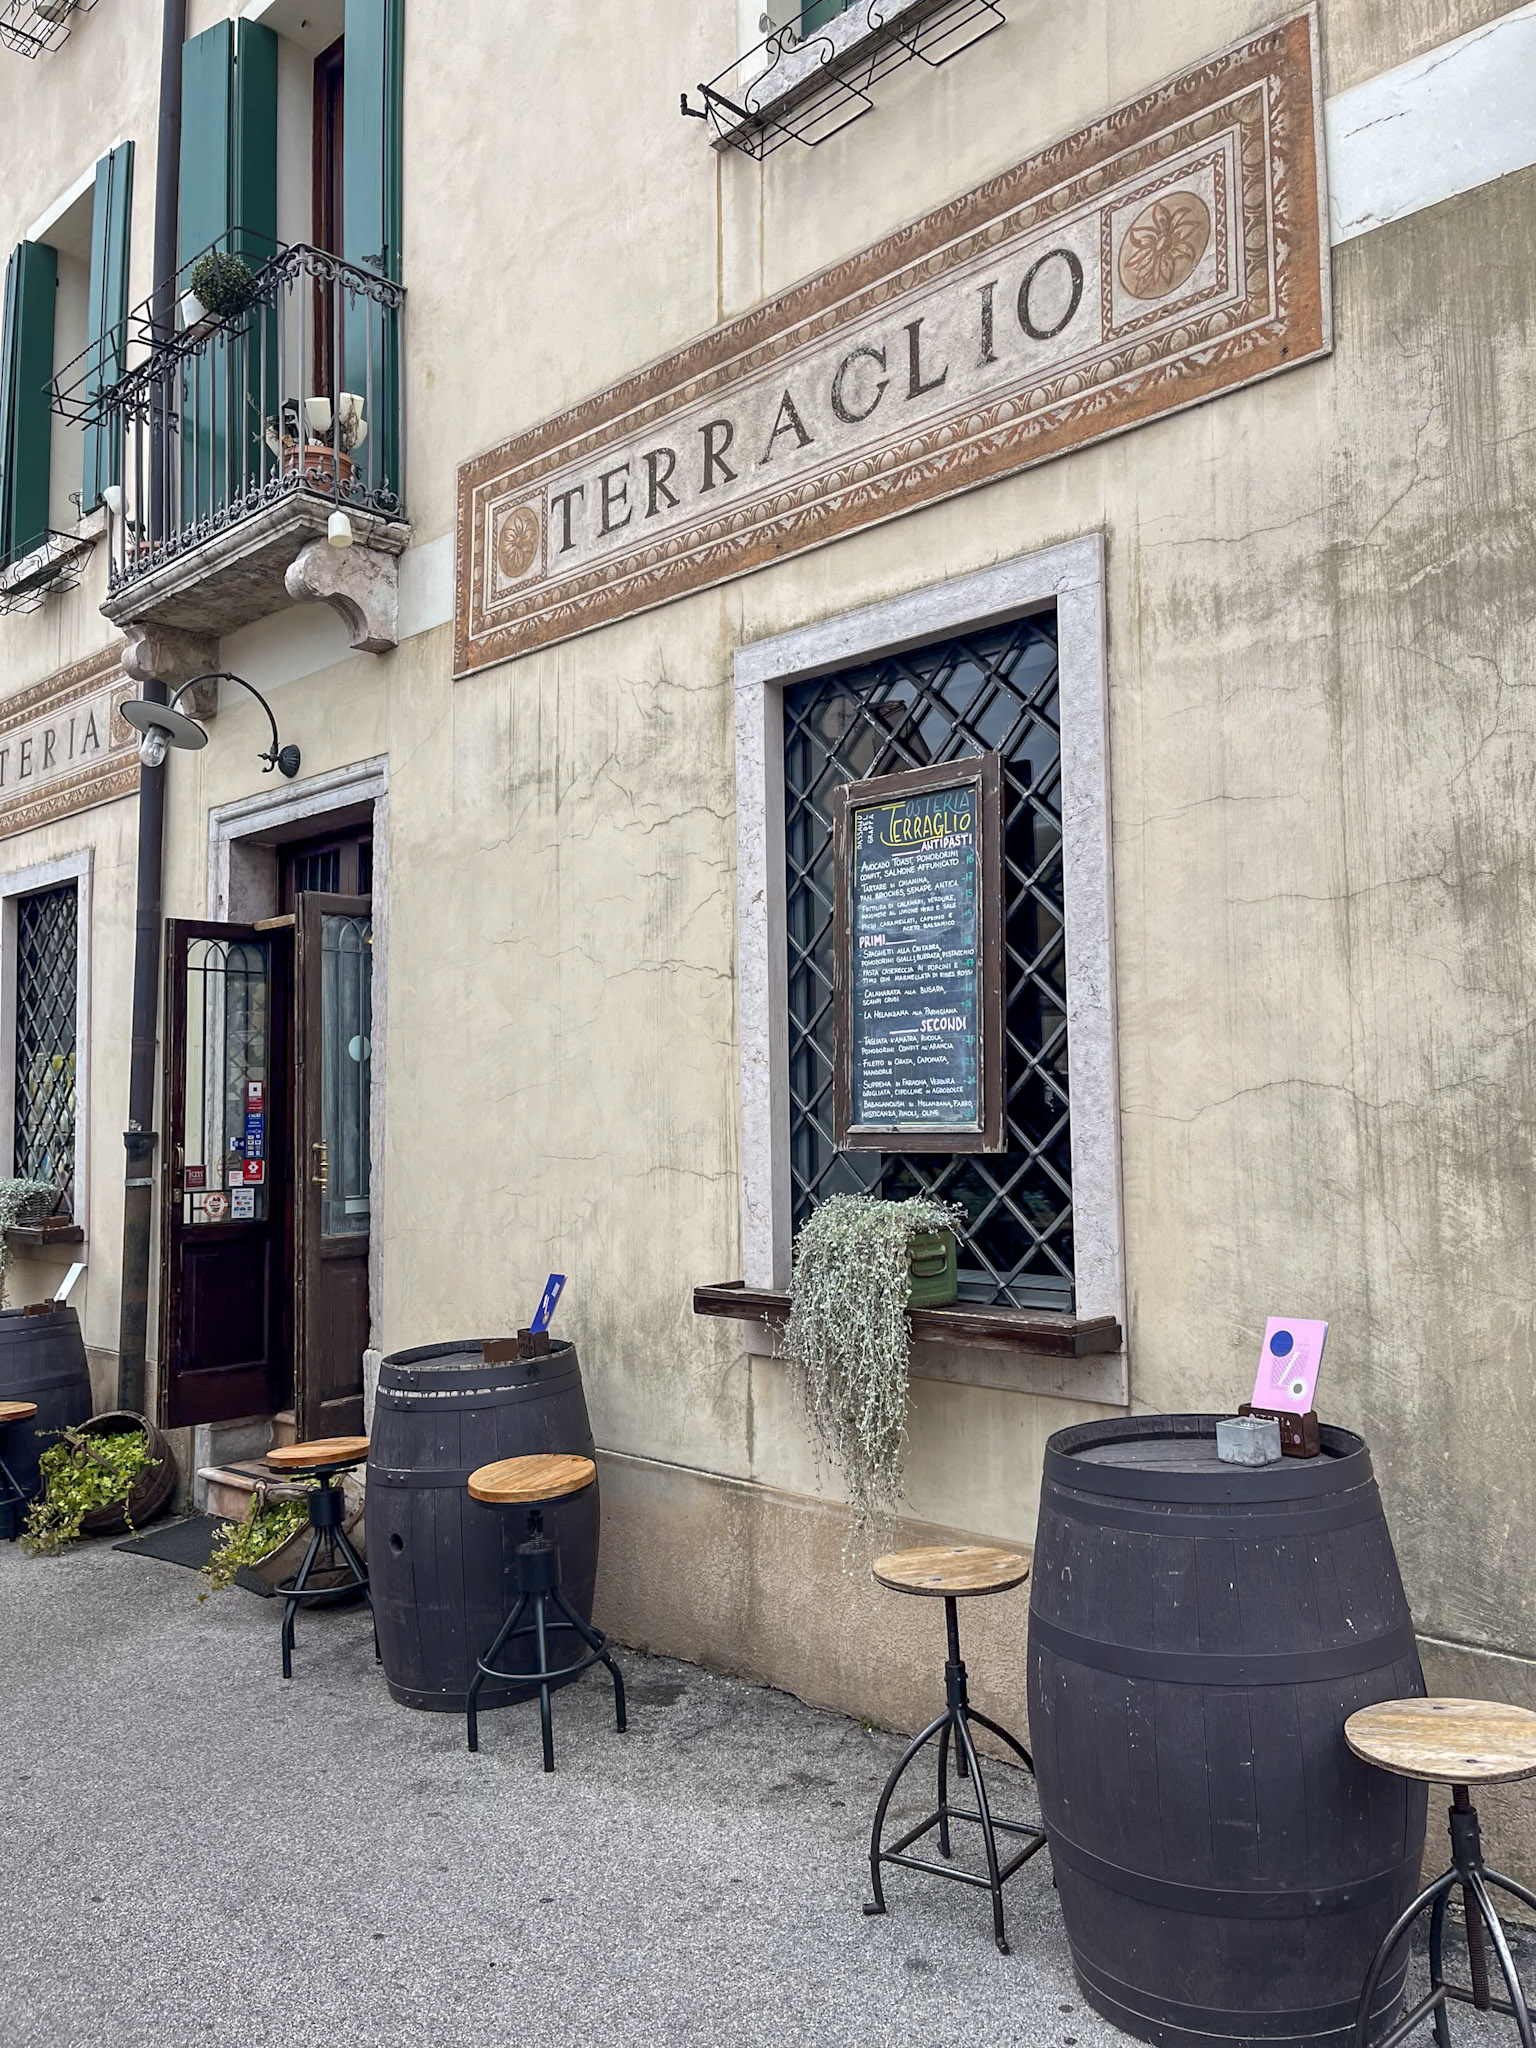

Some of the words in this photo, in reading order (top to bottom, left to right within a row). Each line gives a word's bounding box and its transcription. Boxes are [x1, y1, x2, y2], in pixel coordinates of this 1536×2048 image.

[550, 248, 1084, 554] TERRAGLIO
[906, 792, 970, 818] OSTERIA
[867, 813, 875, 844] GRAPPA
[881, 804, 971, 846] TERRAGLIO
[921, 833, 972, 852] ANTIPASTI
[861, 861, 890, 872] AVOCADO
[884, 866, 915, 878] SALMONE
[861, 883, 887, 893] TARTARE
[907, 885, 932, 895] SENAPE
[935, 880, 959, 890] ANTICA
[920, 913, 945, 922] CAPRINO
[902, 924, 921, 932] ACETO
[923, 920, 955, 929] BALSAMICO
[859, 934, 886, 948] PRIMI
[863, 949, 894, 959] SPAGHETTI
[942, 949, 975, 958] PISTACCHIO
[953, 961, 959, 969] E
[920, 985, 947, 995] BUSARA,
[863, 1011, 872, 1020] LA
[920, 1016, 967, 1032] SECONDI
[863, 1036, 888, 1046] TAGLIATA
[898, 1044, 920, 1052] CONFIT
[862, 1058, 885, 1068] FILETTO
[931, 1085, 964, 1095] AGRODOLCE
